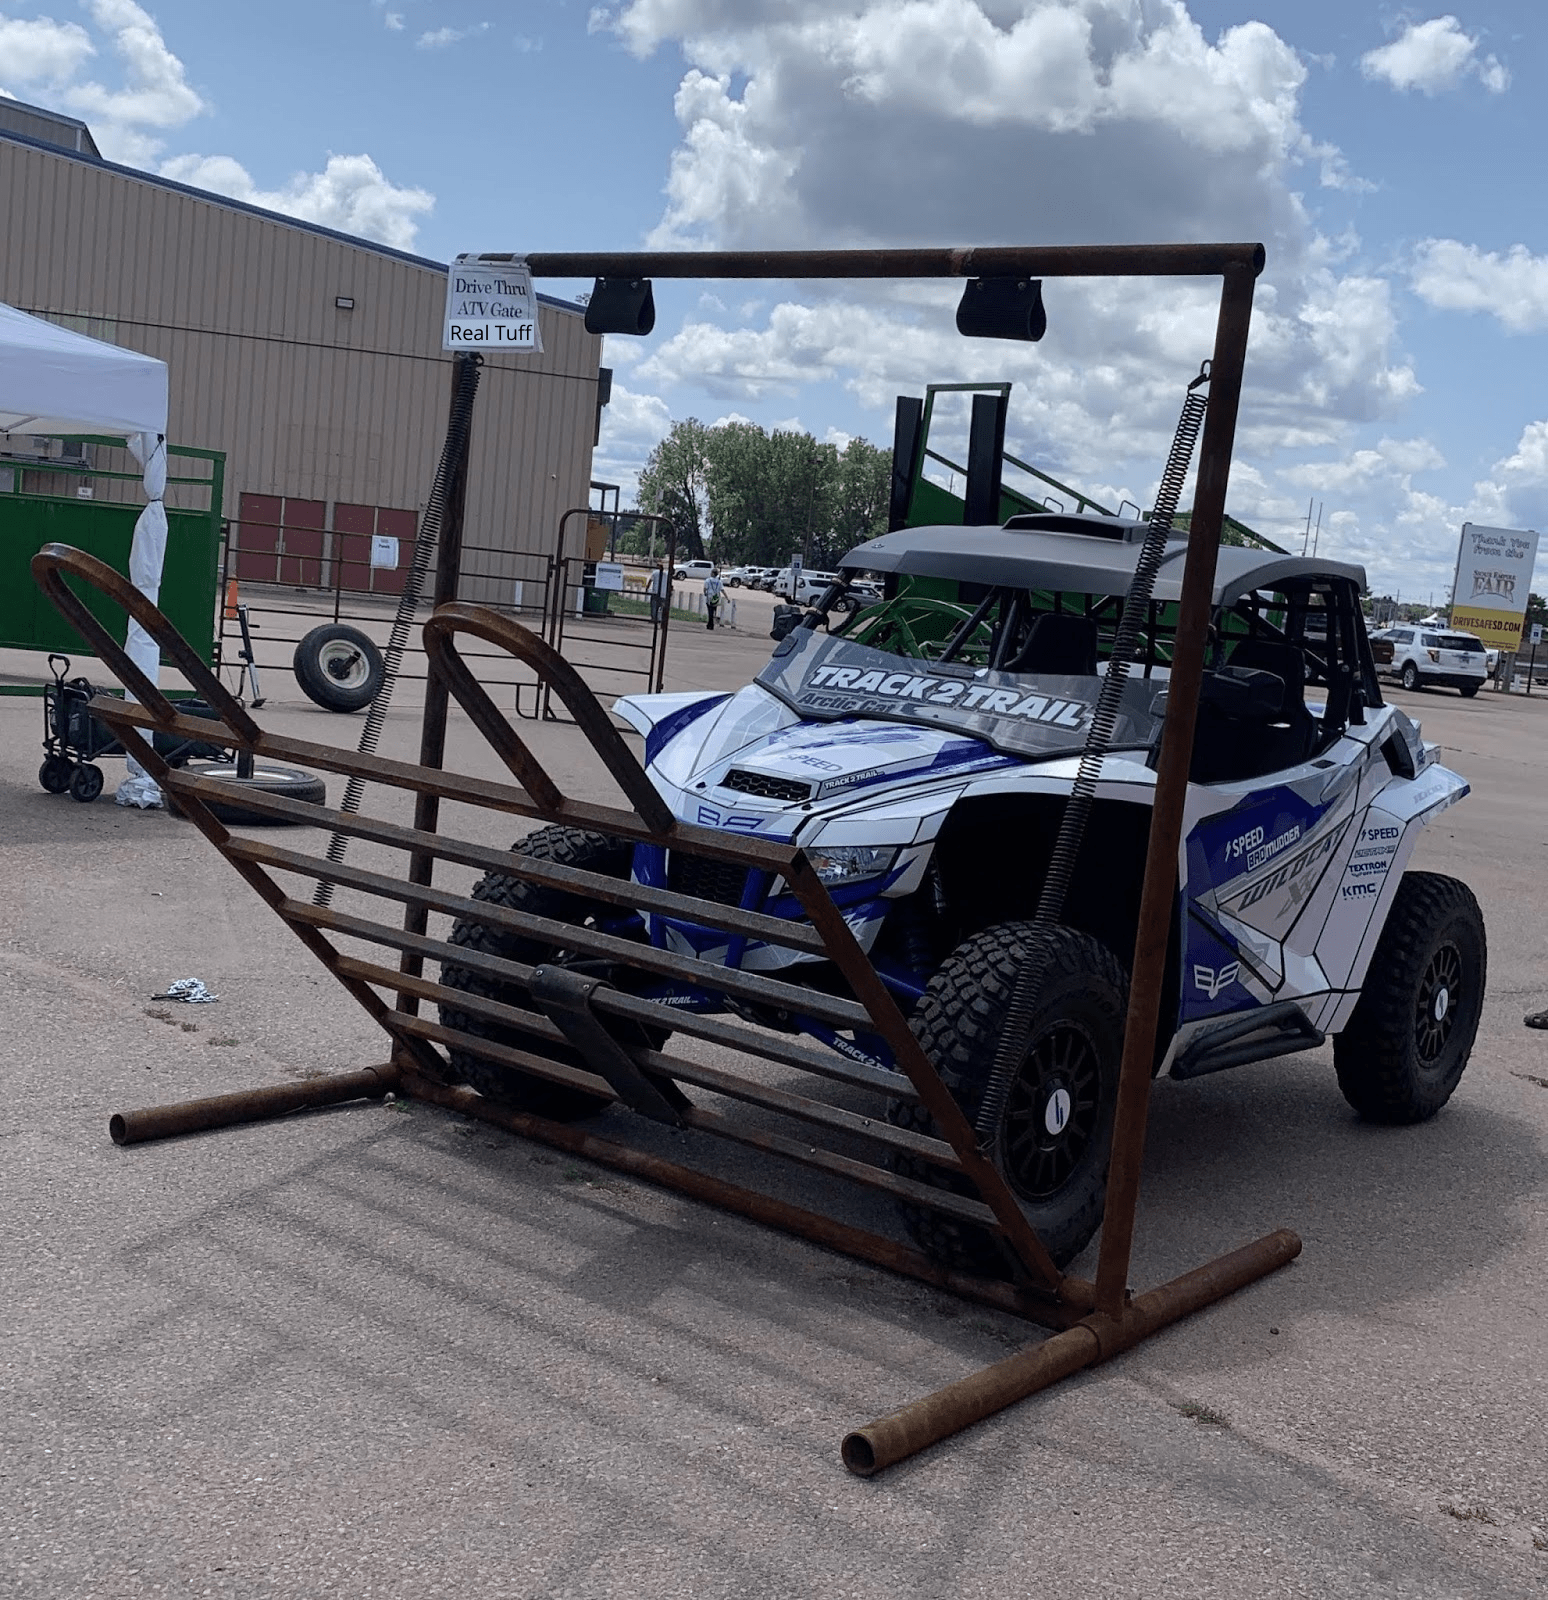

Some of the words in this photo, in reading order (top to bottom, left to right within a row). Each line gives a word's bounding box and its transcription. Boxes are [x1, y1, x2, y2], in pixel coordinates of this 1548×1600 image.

[455, 278, 492, 294] Drive
[494, 279, 526, 296] Thru
[457, 301, 489, 316] ATV
[490, 302, 522, 318] Gate
[1471, 533, 1506, 547] Thank
[1471, 577, 1515, 602] FAIR
[1452, 616, 1522, 632] DRIVESAFESD.COM
[798, 692, 857, 711] Arctic
[860, 699, 896, 714] Cat
[781, 754, 843, 772] SPEED
[1232, 825, 1264, 858] SPEED
[1368, 827, 1399, 840] SPEED
[1348, 861, 1387, 873] TEXTRON
[1342, 882, 1377, 897] KMC
